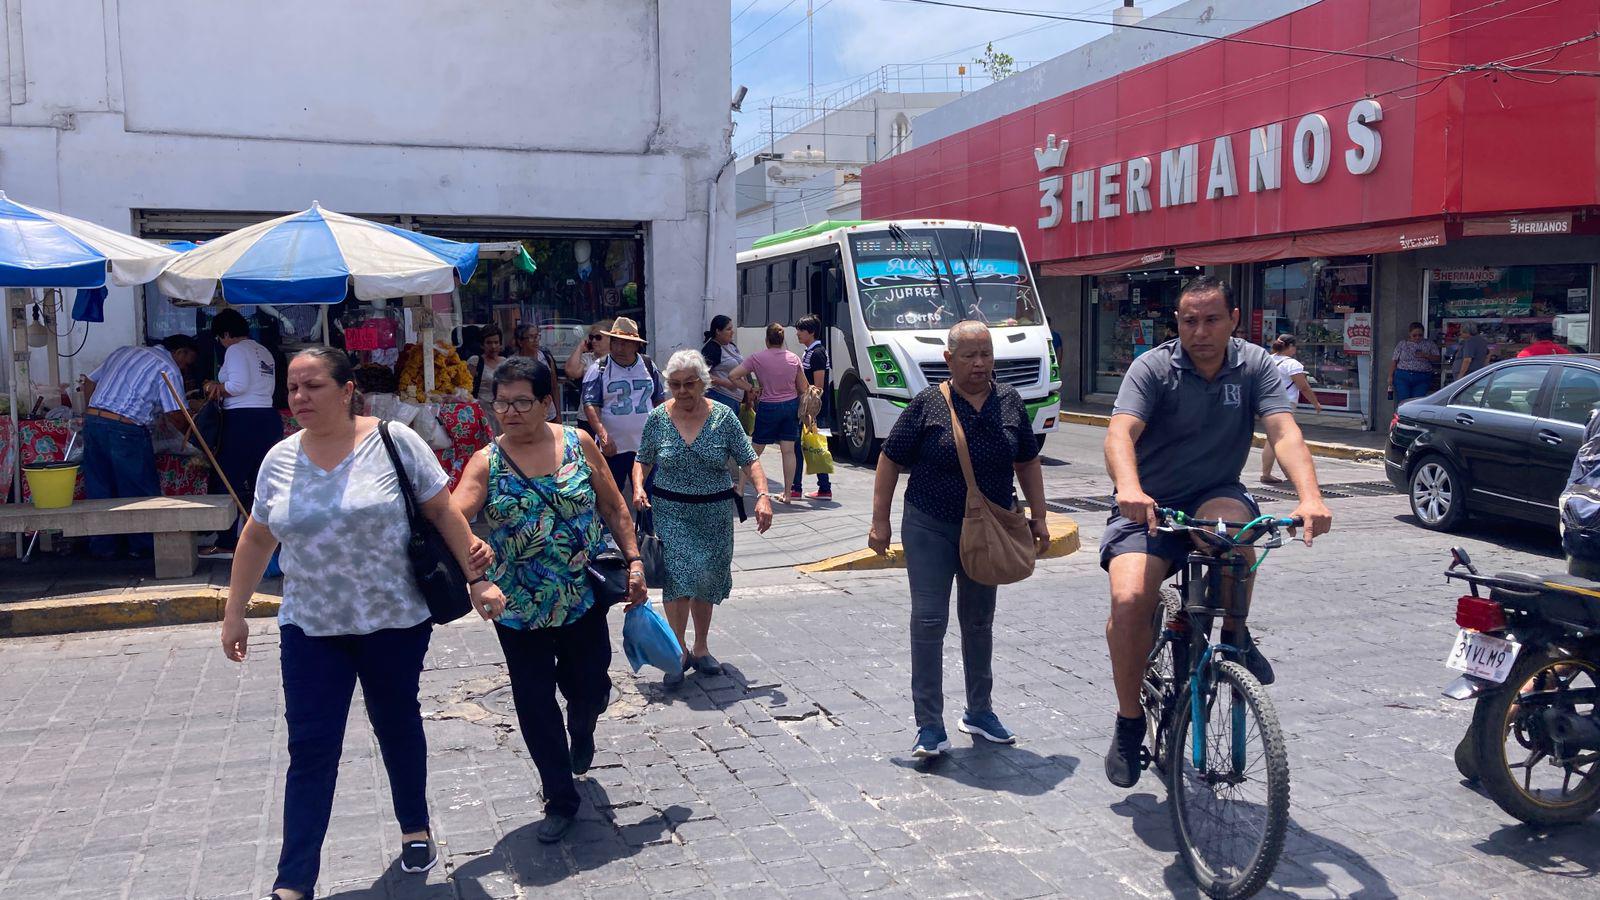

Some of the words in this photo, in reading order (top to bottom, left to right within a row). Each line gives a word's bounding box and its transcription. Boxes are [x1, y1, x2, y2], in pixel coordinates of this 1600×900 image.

[1038, 175, 1063, 229] 3
[1071, 99, 1383, 223] HERMANOS
[1518, 221, 1568, 233] HERMANOS
[1441, 271, 1495, 281] HERMANOS
[885, 287, 939, 302] JUAREZ
[607, 380, 653, 415] 37
[1456, 642, 1506, 668] 31VLM9
